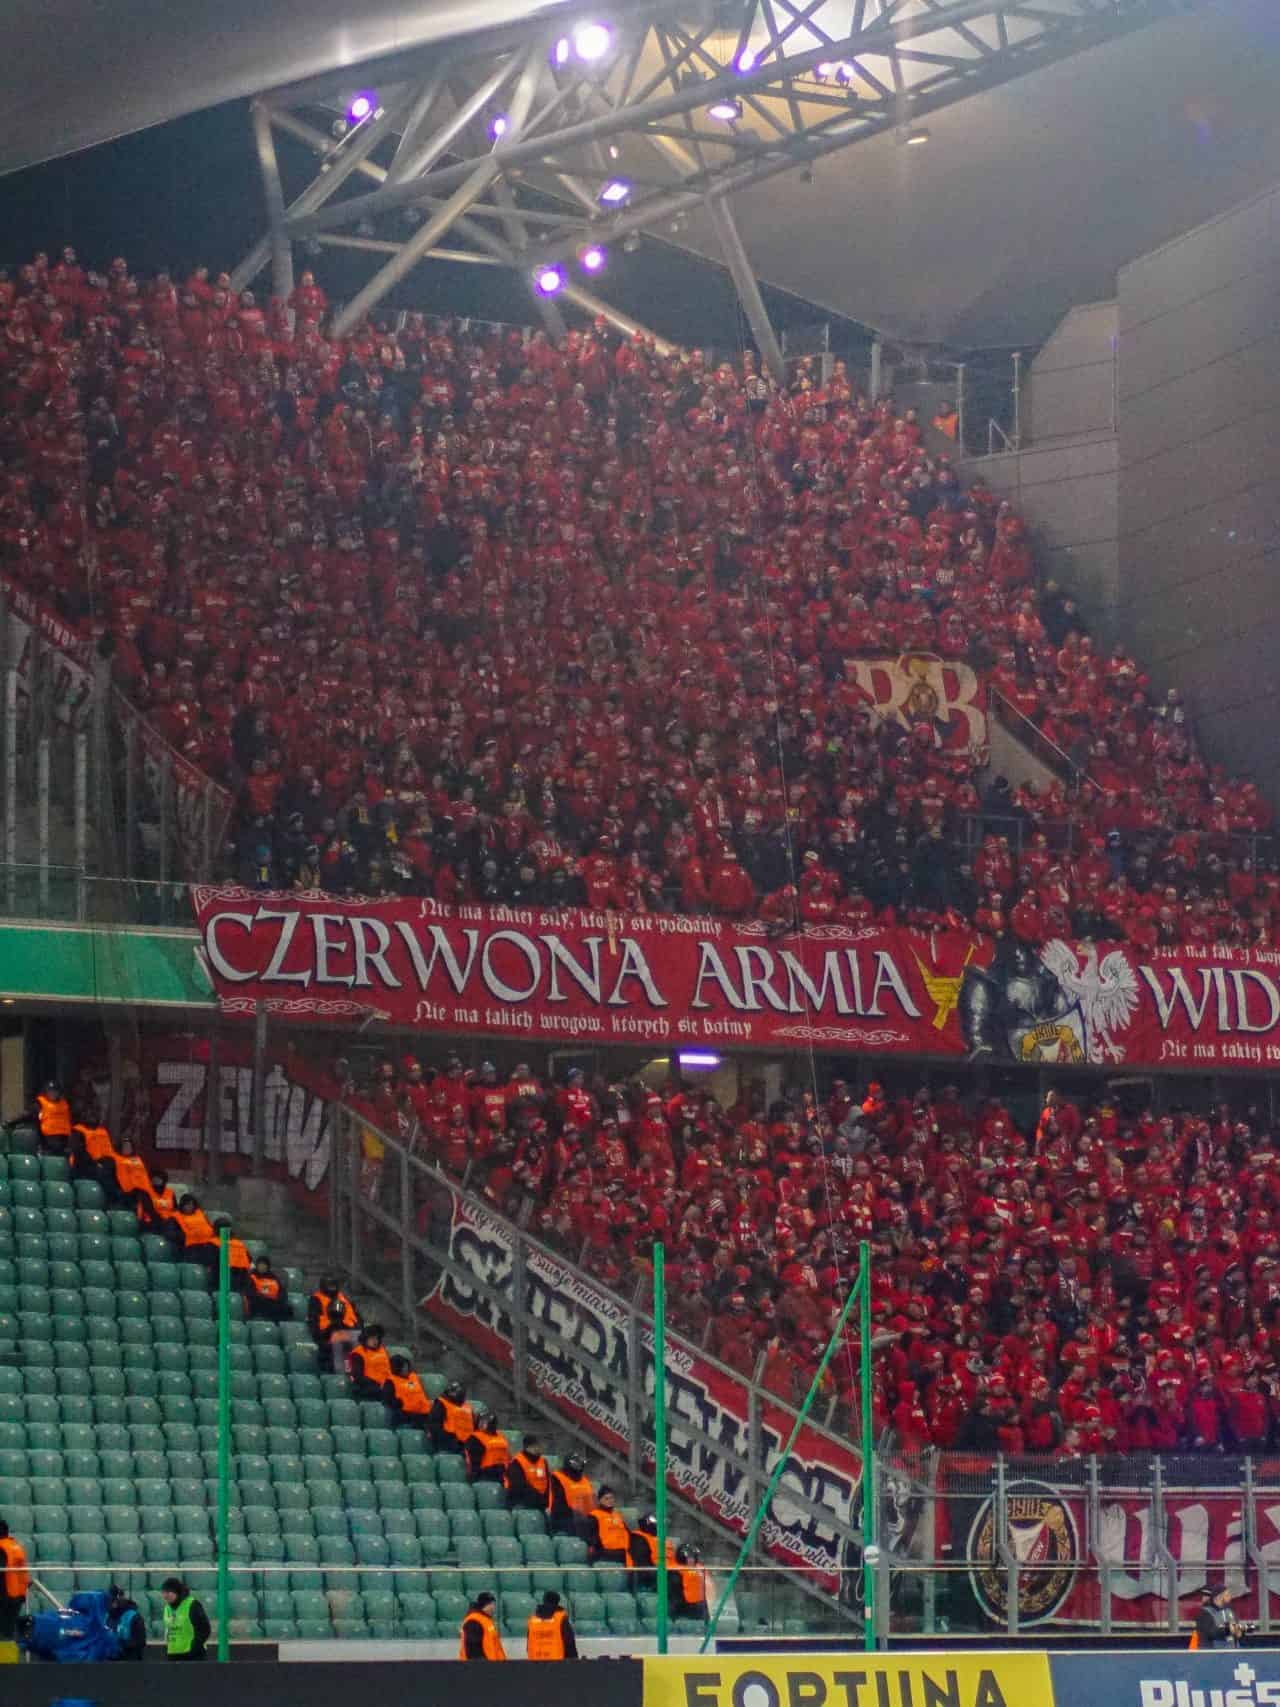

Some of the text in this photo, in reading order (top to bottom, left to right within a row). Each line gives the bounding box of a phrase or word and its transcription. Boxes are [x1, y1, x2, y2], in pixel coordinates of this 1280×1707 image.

[205, 904, 923, 1018] CZERWONA ARMIA
[413, 999, 446, 1023] Nie
[454, 1006, 479, 1024] ma
[682, 1668, 1008, 1707] FORTUNA
